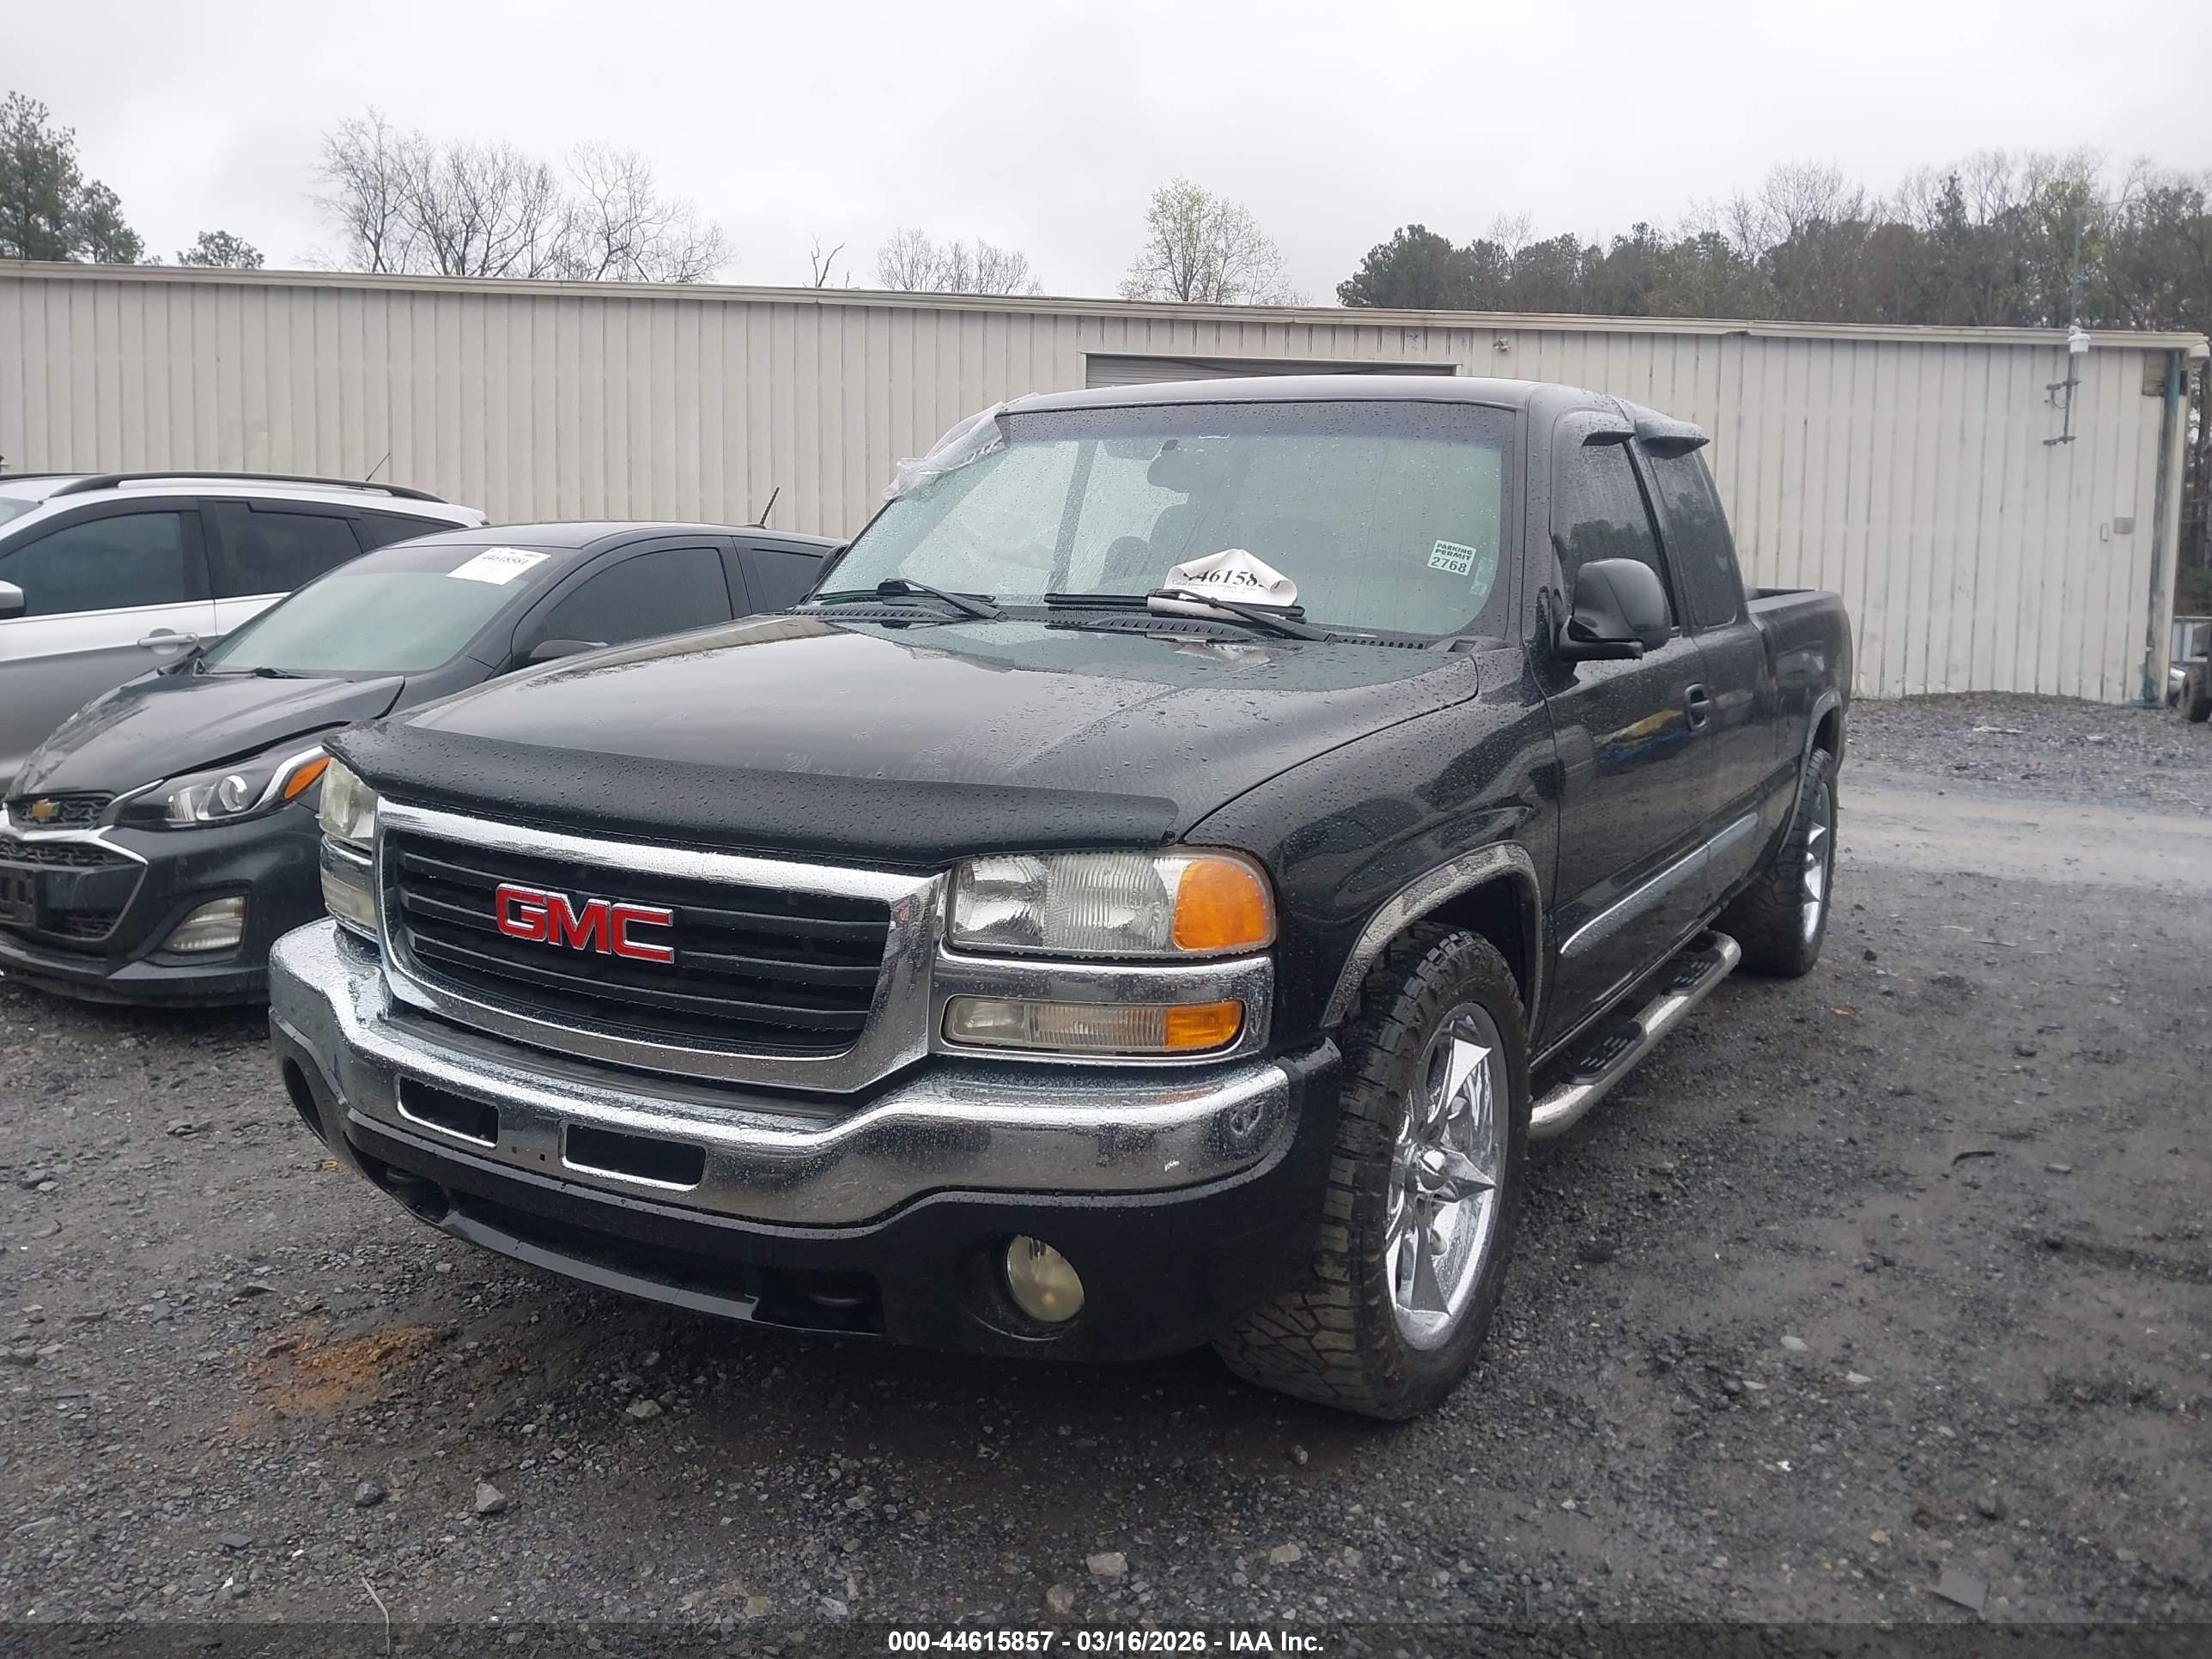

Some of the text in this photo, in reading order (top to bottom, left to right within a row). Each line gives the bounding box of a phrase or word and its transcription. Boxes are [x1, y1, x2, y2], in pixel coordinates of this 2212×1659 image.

[1435, 548, 1472, 561] PERMIT
[1437, 543, 1474, 556] PARKING
[1431, 556, 1468, 574] 2768
[1183, 568, 1281, 589] 46158
[495, 883, 675, 963] GMC
